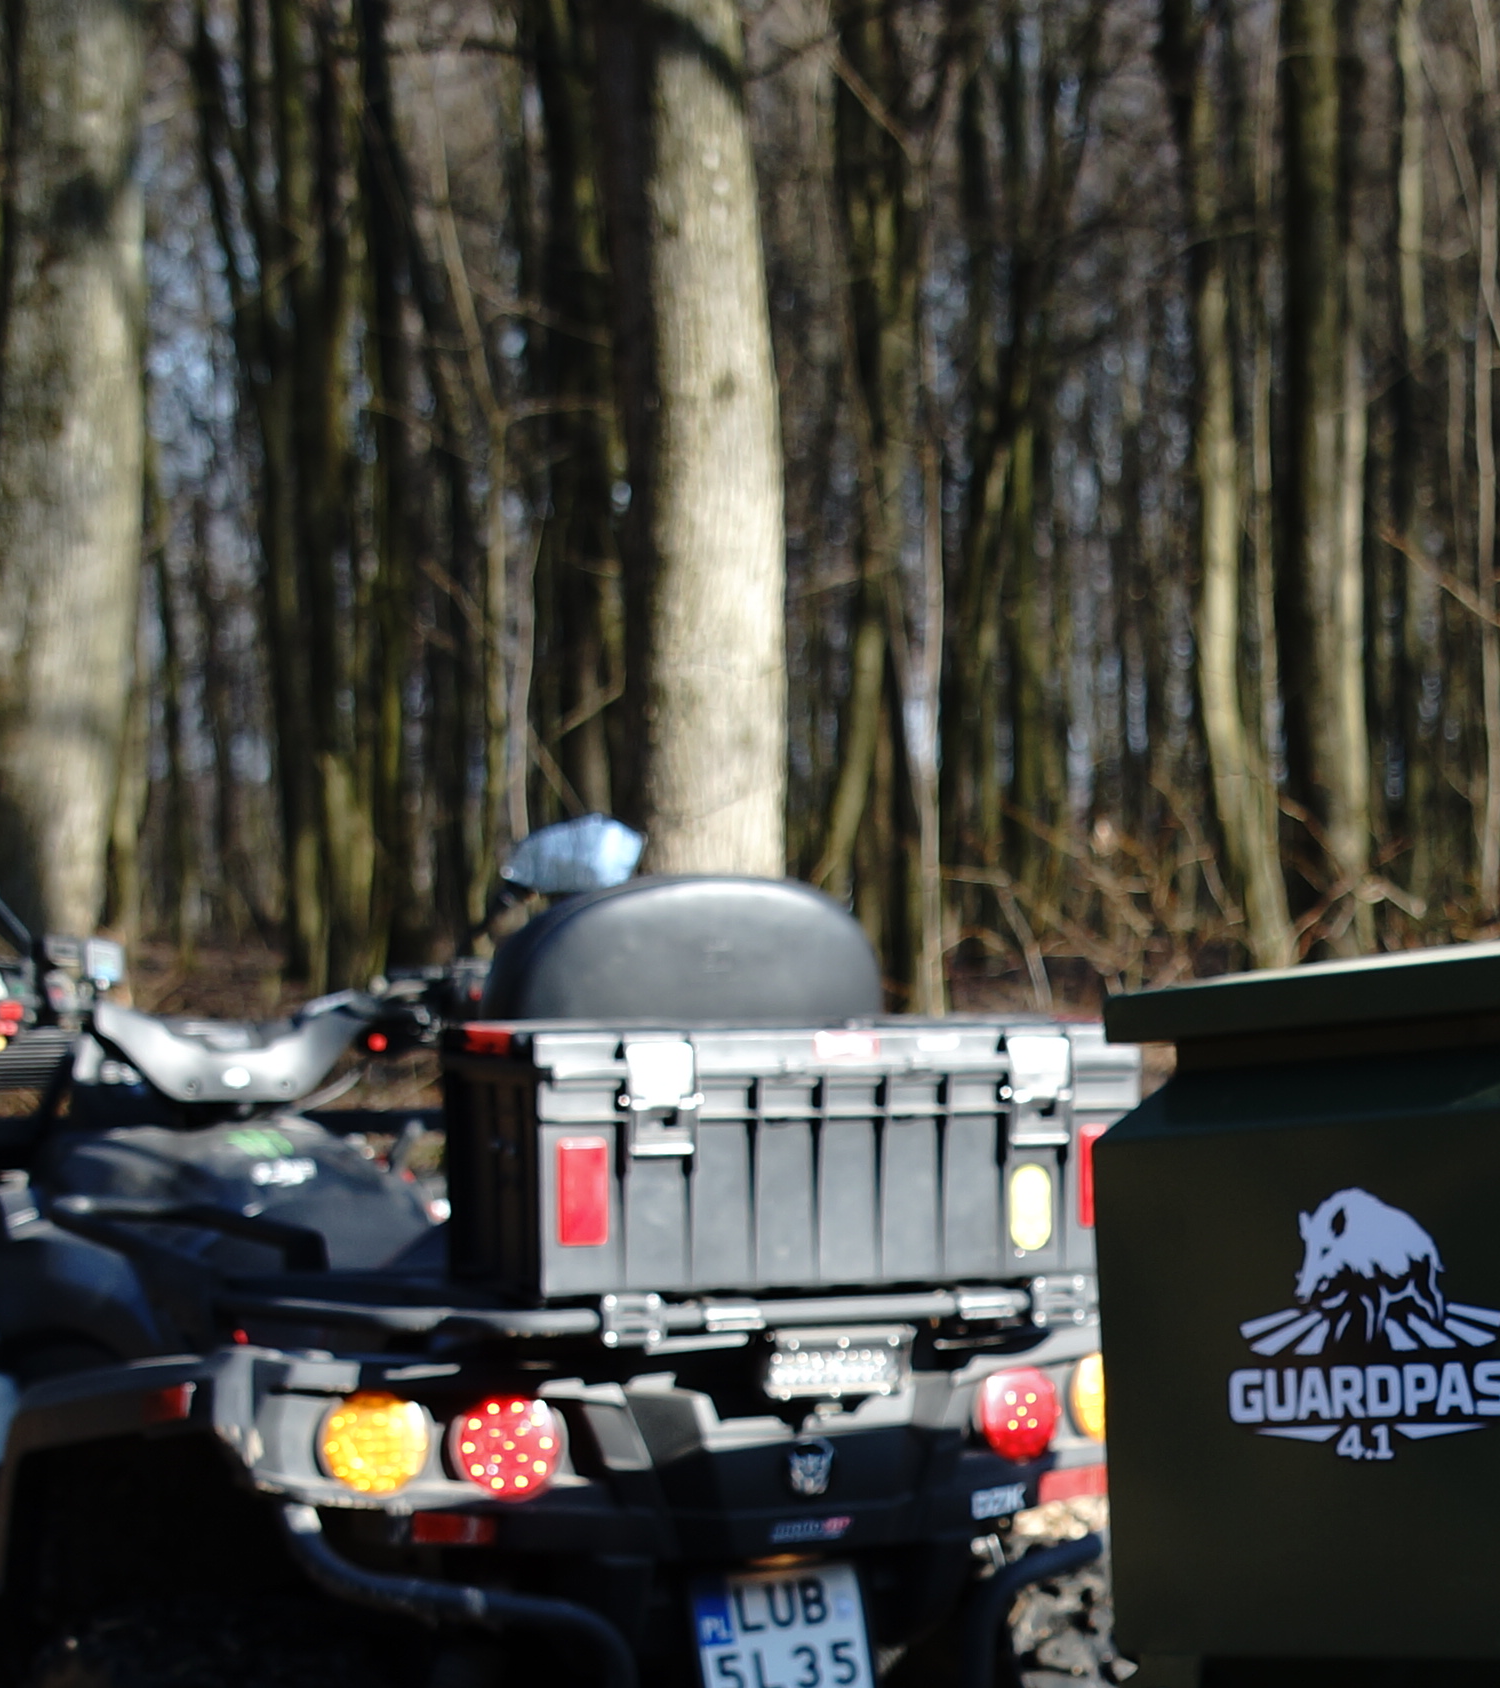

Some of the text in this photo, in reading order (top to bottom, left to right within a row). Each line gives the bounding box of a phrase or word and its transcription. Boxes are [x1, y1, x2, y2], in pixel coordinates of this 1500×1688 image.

[1336, 1424, 1394, 1460] 4.1
[732, 1576, 828, 1632] LUB
[699, 1615, 734, 1641] PL
